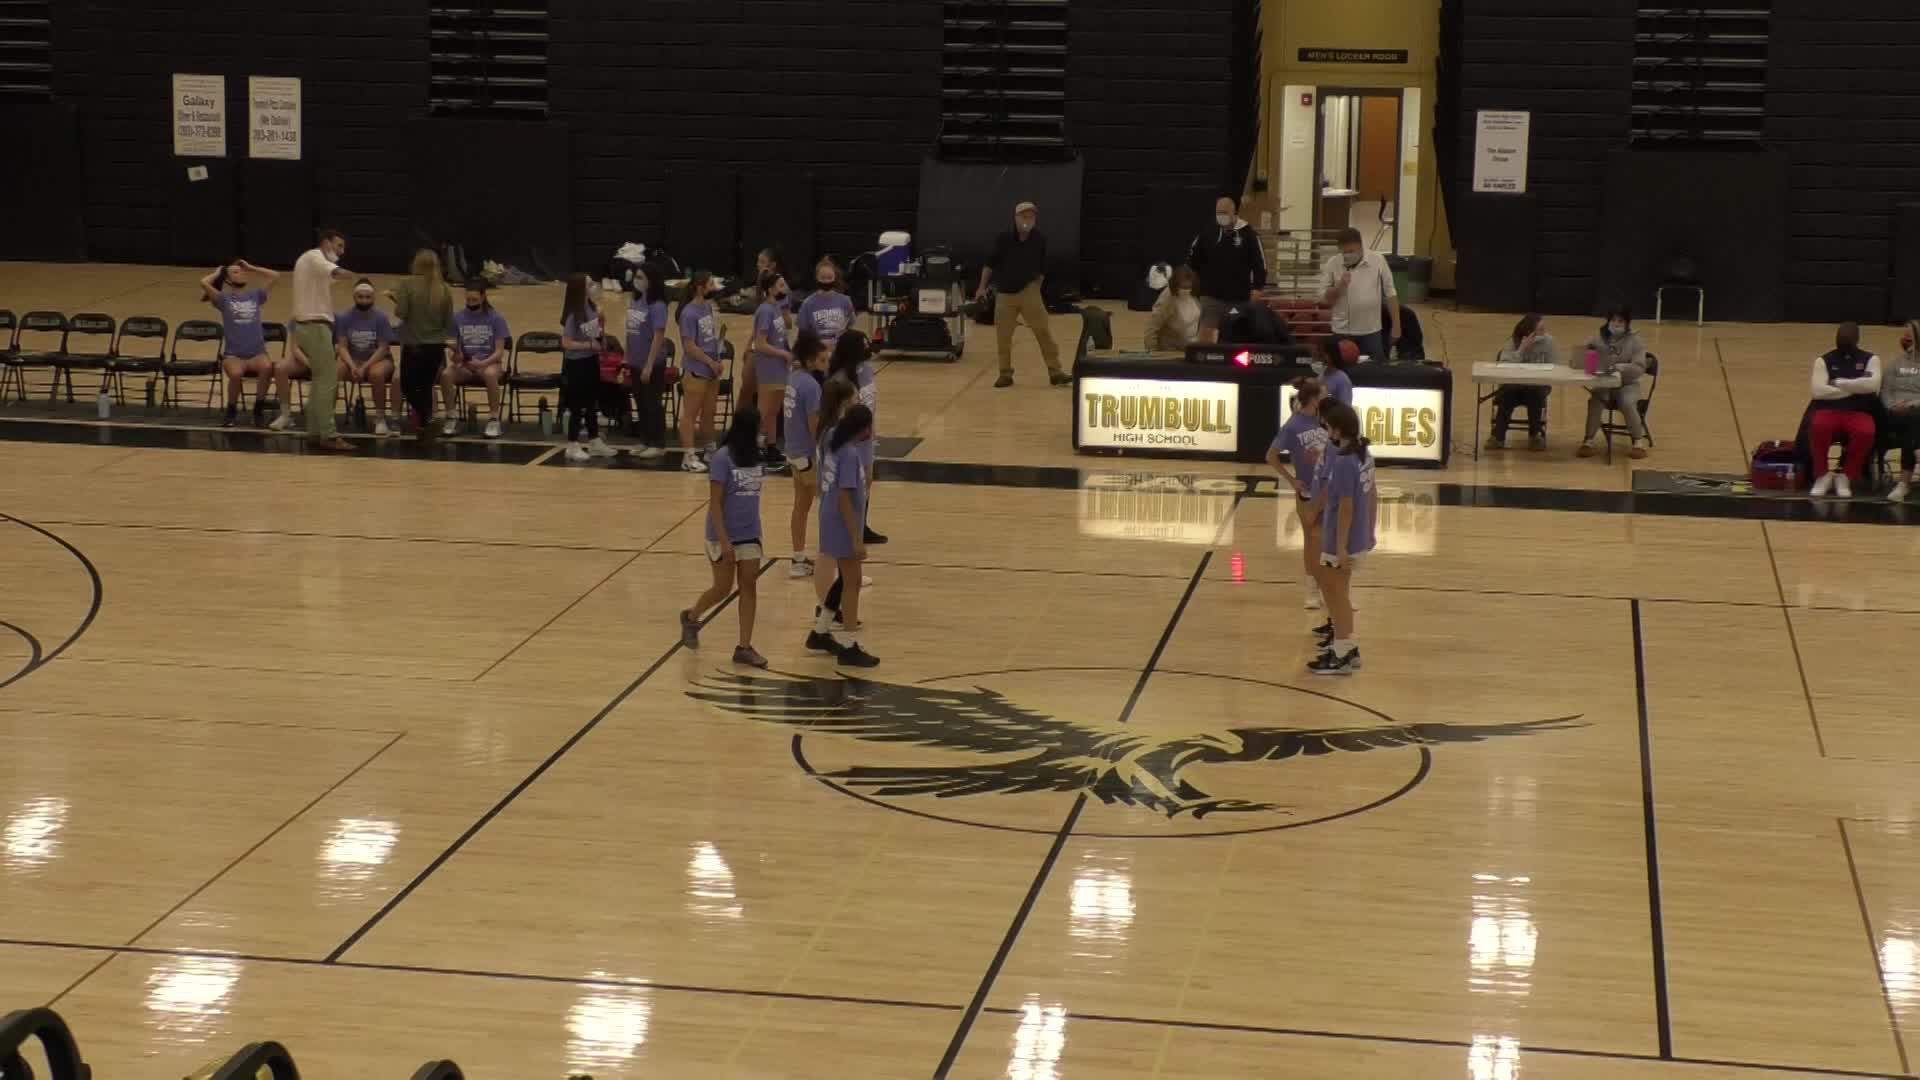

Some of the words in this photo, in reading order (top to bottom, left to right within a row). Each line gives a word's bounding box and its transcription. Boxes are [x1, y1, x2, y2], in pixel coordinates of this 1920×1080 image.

[1336, 51, 1370, 60] LOCKER
[1372, 52, 1398, 60] ROOM
[182, 95, 216, 109] Galaxy
[1085, 393, 1232, 434] TRUMBULL
[1353, 405, 1437, 448] GLES
[1113, 433, 1144, 444] HIGH
[1147, 433, 1199, 446] SCHOOL
